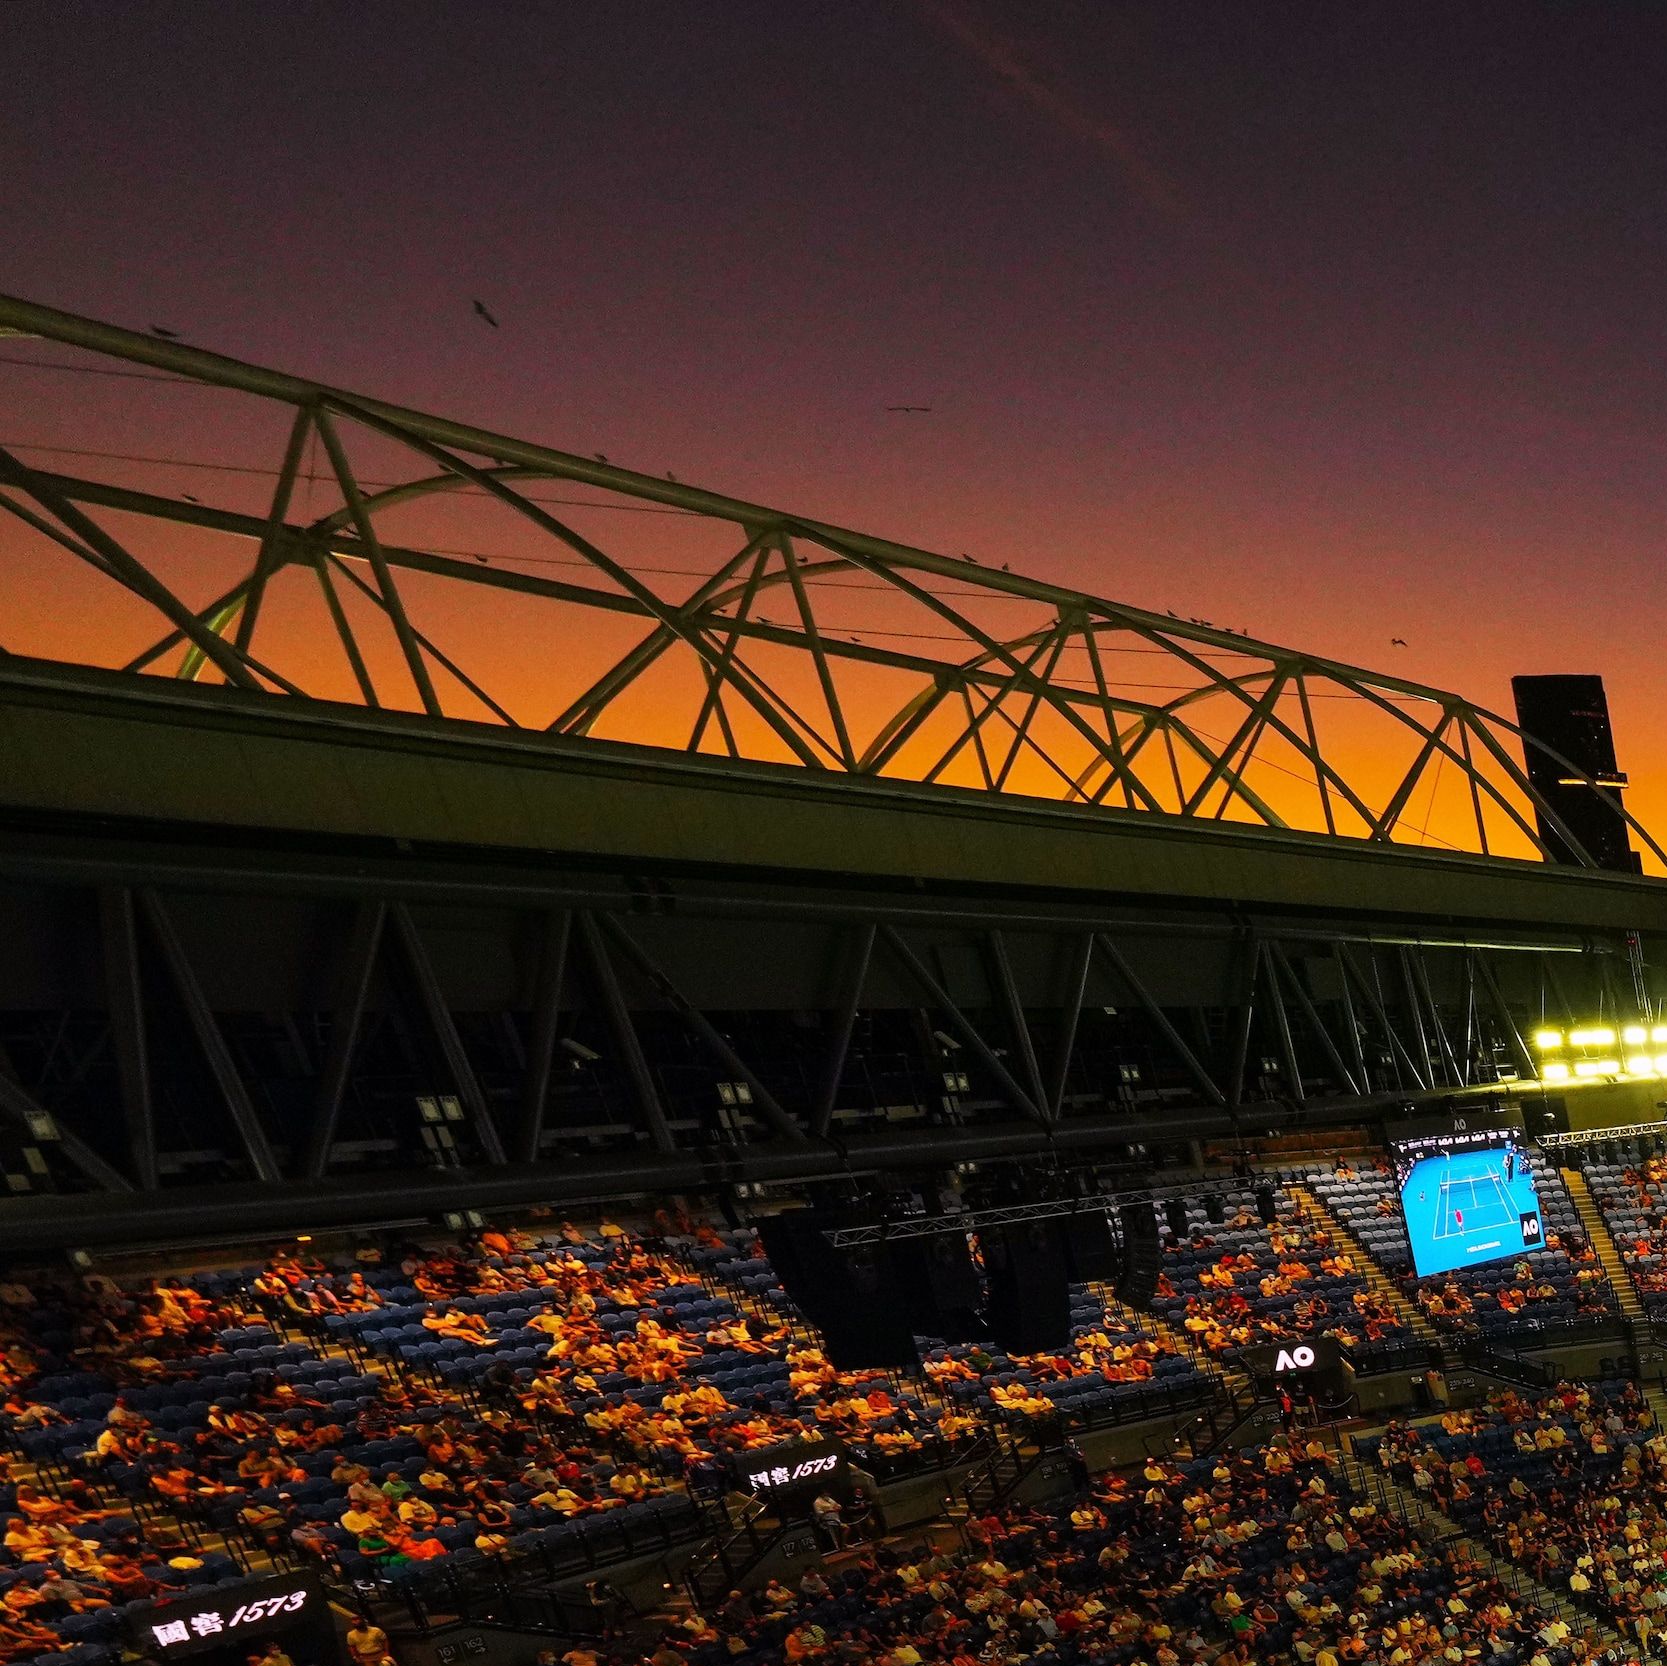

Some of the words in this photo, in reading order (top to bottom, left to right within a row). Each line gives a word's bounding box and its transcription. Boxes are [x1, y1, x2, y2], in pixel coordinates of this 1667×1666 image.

[1523, 1219, 1539, 1236] AO
[1276, 1347, 1314, 1371] AO
[463, 1636, 483, 1649] 162
[438, 1644, 456, 1659] 161
